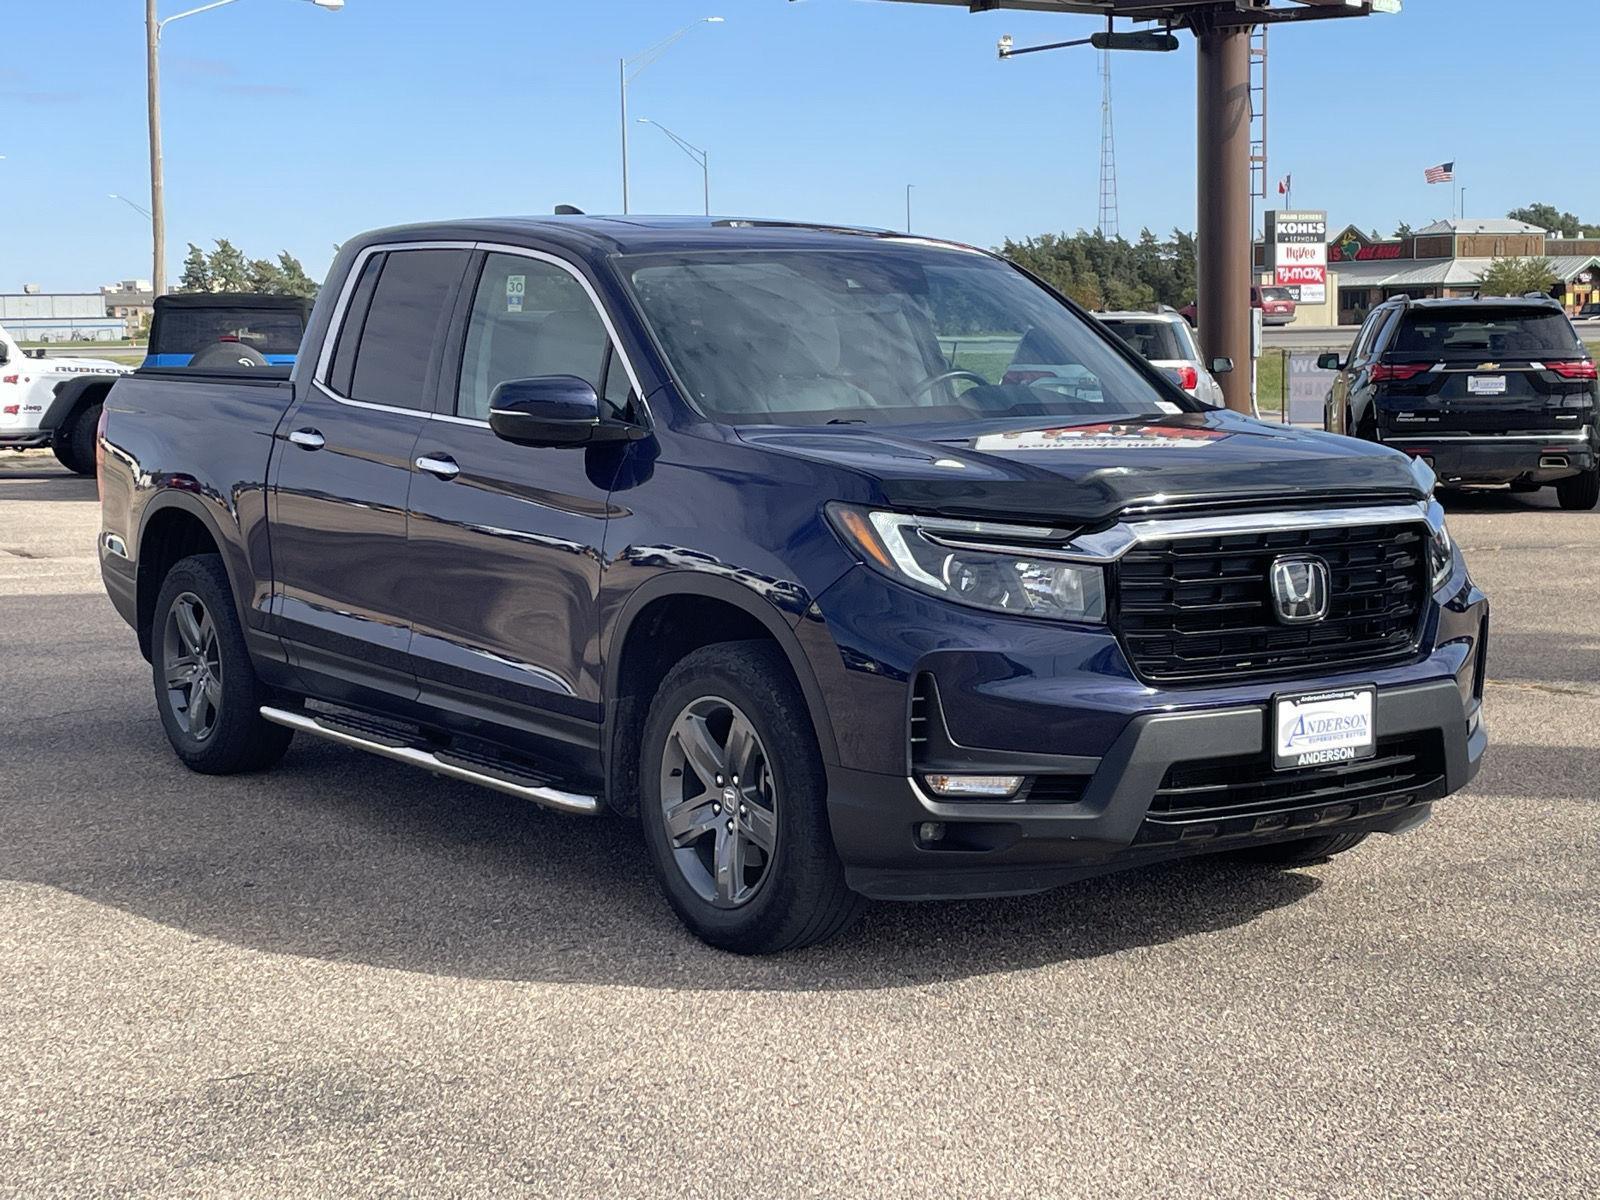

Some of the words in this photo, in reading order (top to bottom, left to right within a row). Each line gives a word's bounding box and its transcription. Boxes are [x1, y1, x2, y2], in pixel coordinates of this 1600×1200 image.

[1277, 222, 1325, 234] KOHL'S
[508, 281, 524, 293] 30
[55, 366, 129, 375] RUBICON
[23, 404, 42, 412] Jeep
[1284, 713, 1369, 748] ANDERSON
[1298, 747, 1355, 766] ANDERSON
